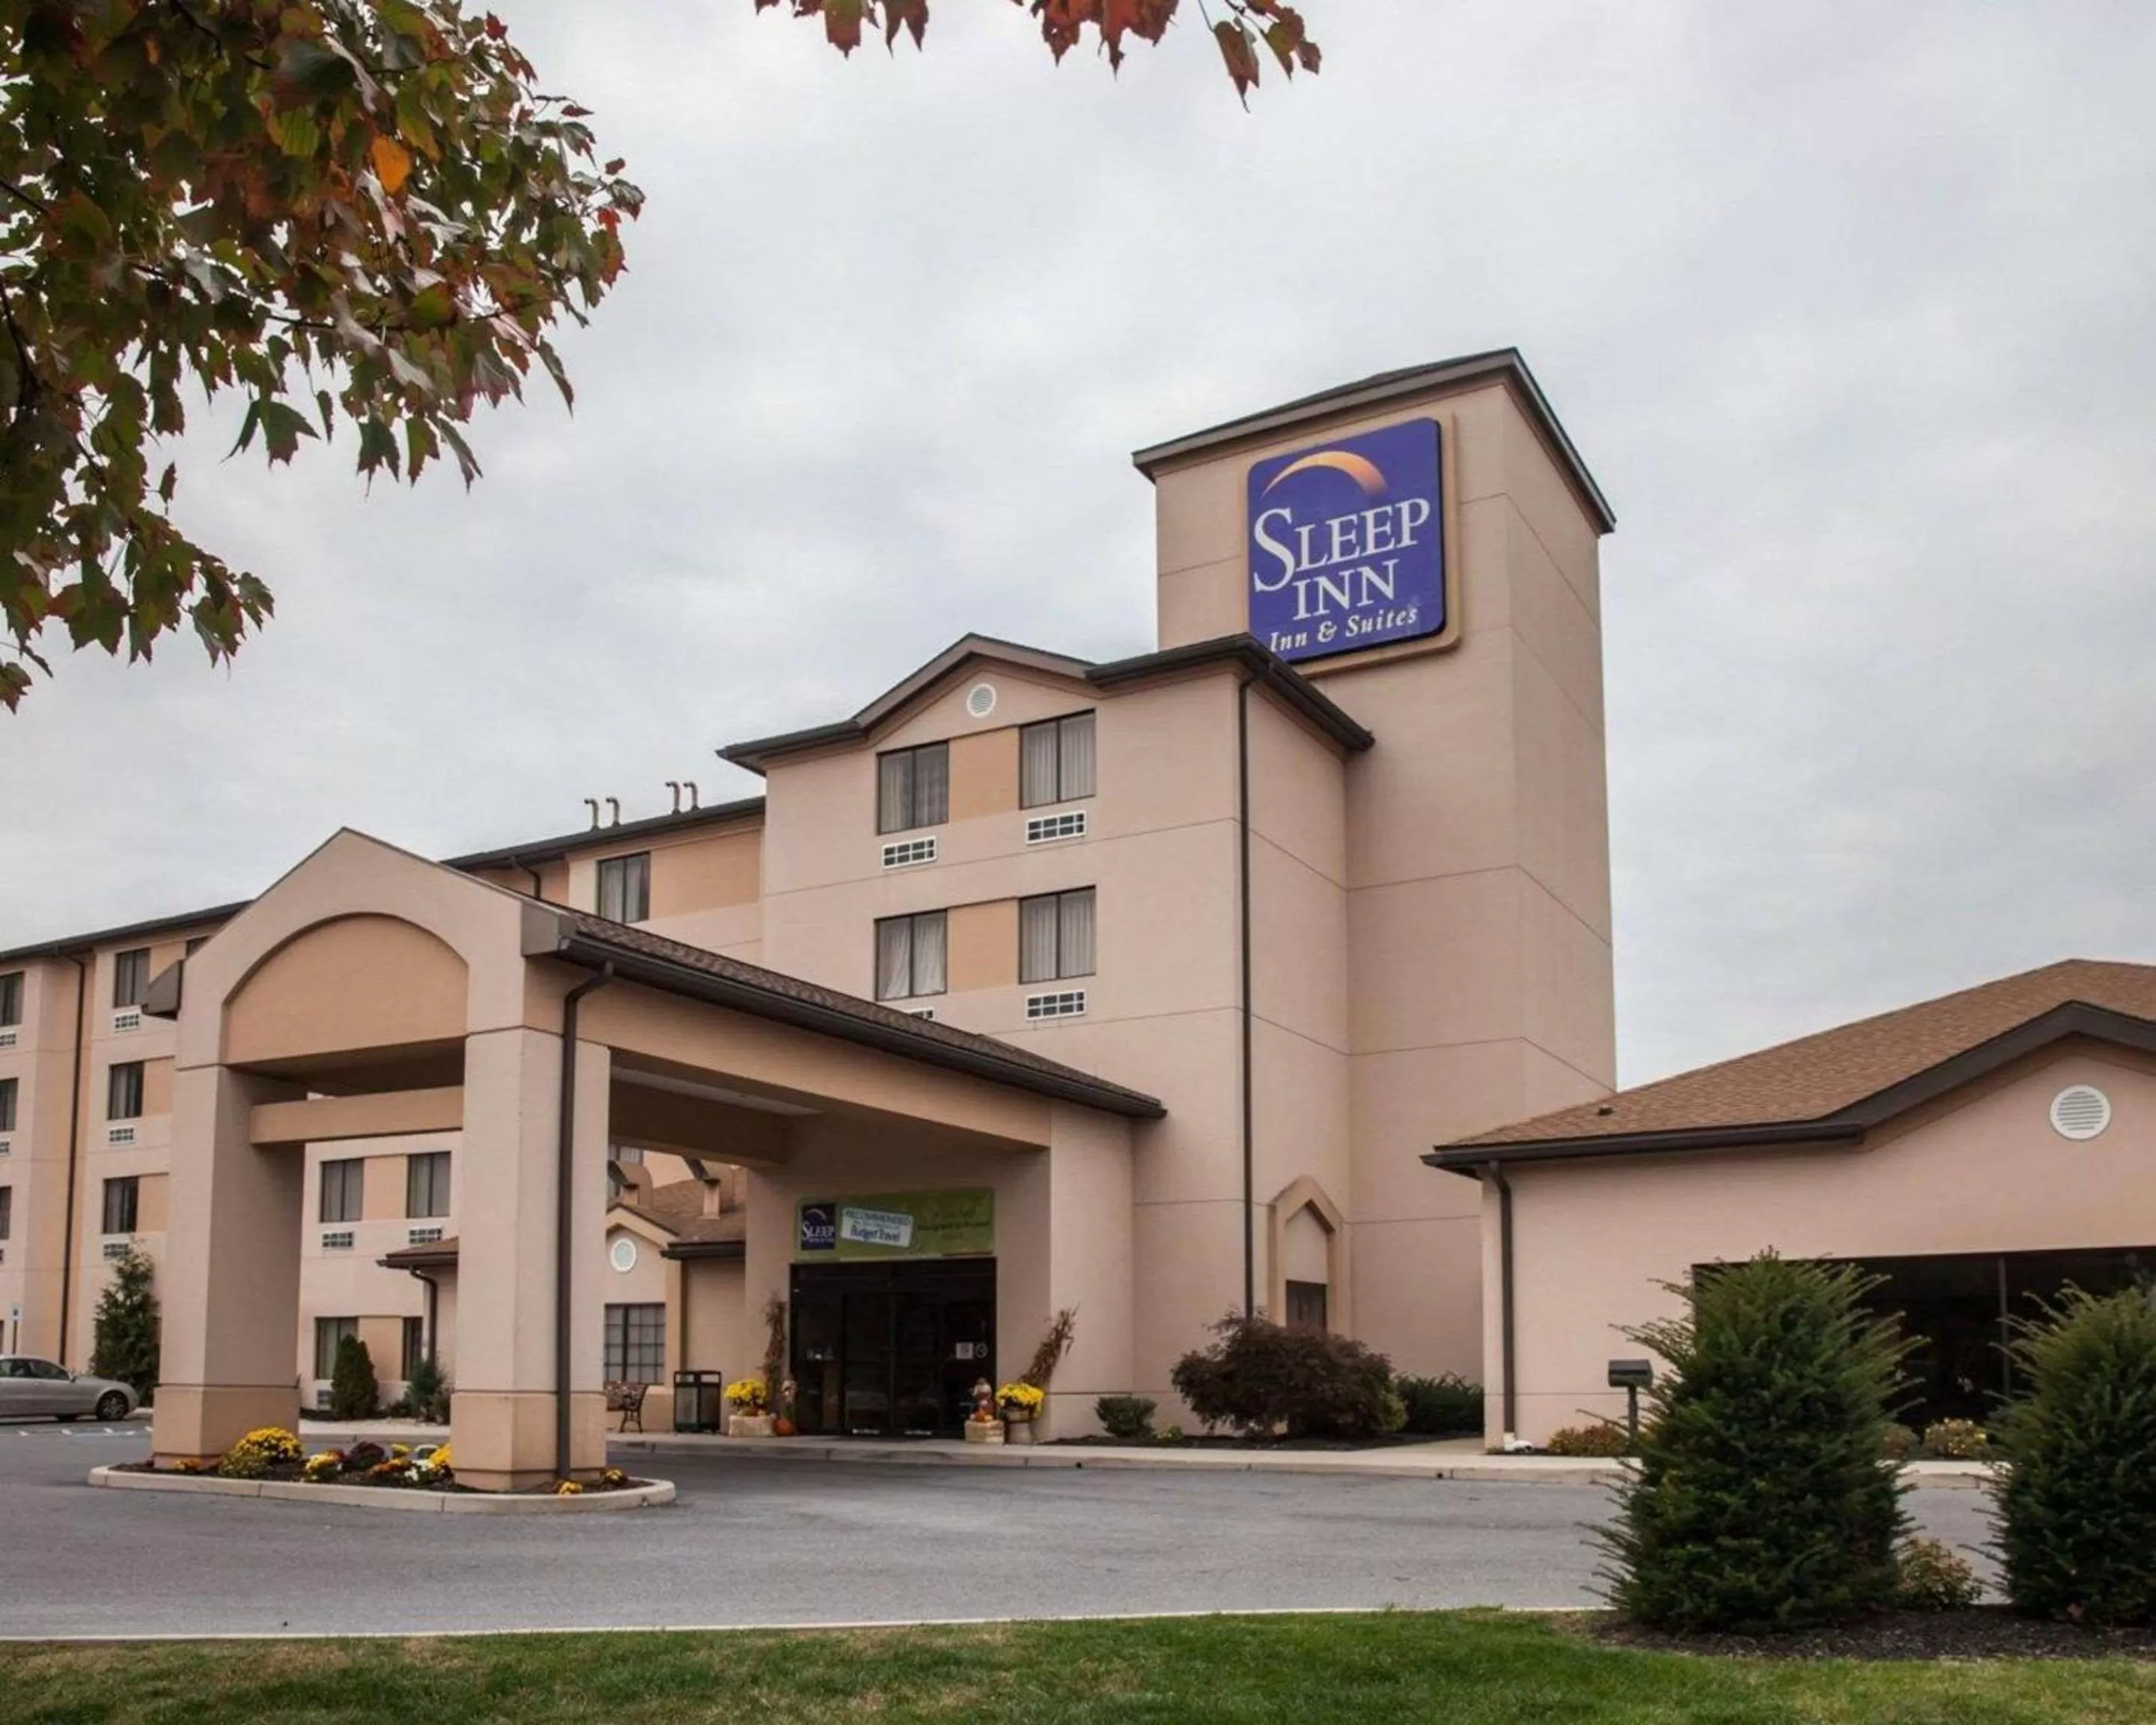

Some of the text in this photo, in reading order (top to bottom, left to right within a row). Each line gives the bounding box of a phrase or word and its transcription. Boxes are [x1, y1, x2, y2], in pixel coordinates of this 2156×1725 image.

[1253, 497, 1431, 593] SLEEP
[1292, 559, 1399, 621] INN
[1270, 606, 1418, 653] Inn & Suites
